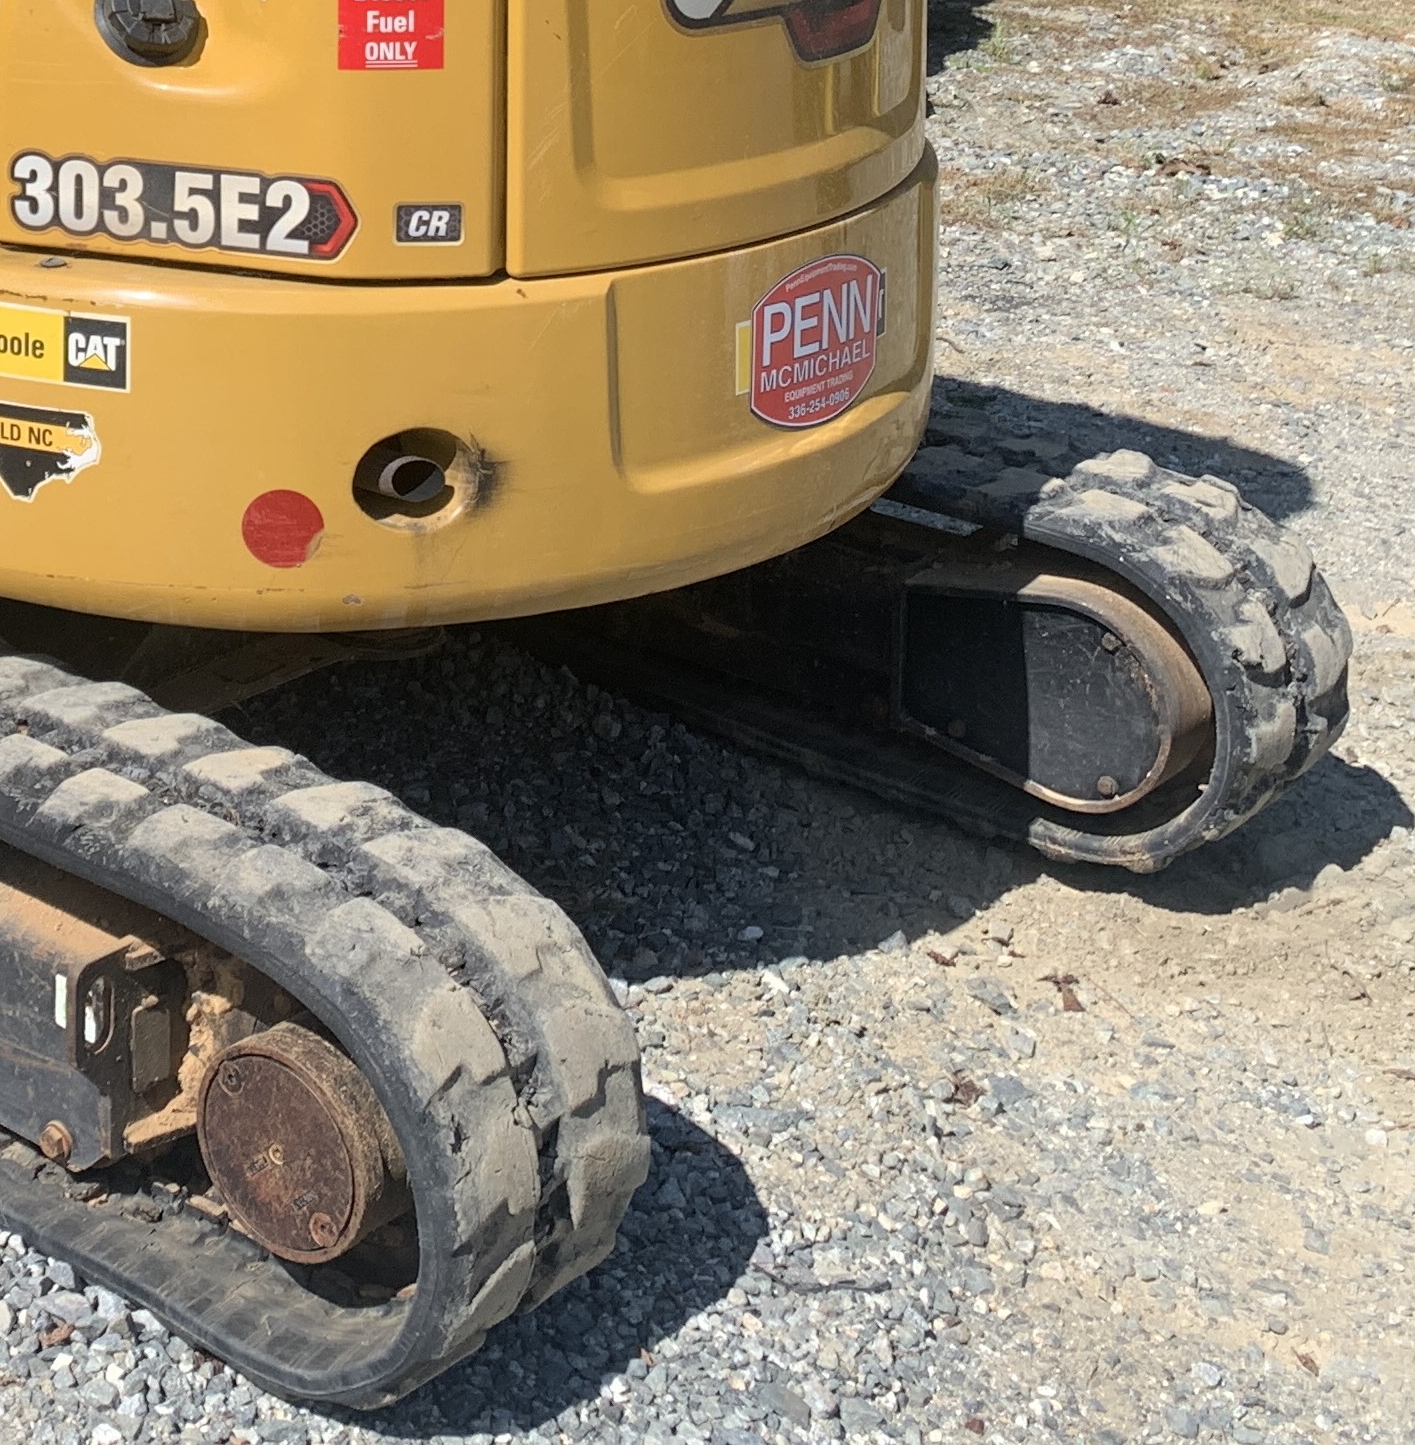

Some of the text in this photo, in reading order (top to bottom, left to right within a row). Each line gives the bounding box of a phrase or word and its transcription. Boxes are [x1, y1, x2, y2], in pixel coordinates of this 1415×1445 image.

[366, 10, 415, 33] Fuel
[365, 41, 417, 61] ONLY
[14, 155, 310, 254] 303.5E2
[407, 208, 451, 239] CR
[762, 274, 873, 367] PENN
[67, 332, 121, 371] CAT
[760, 339, 871, 393] MCMICHAEL
[784, 380, 825, 402] EQUIPMENT
[28, 427, 53, 447] NC
